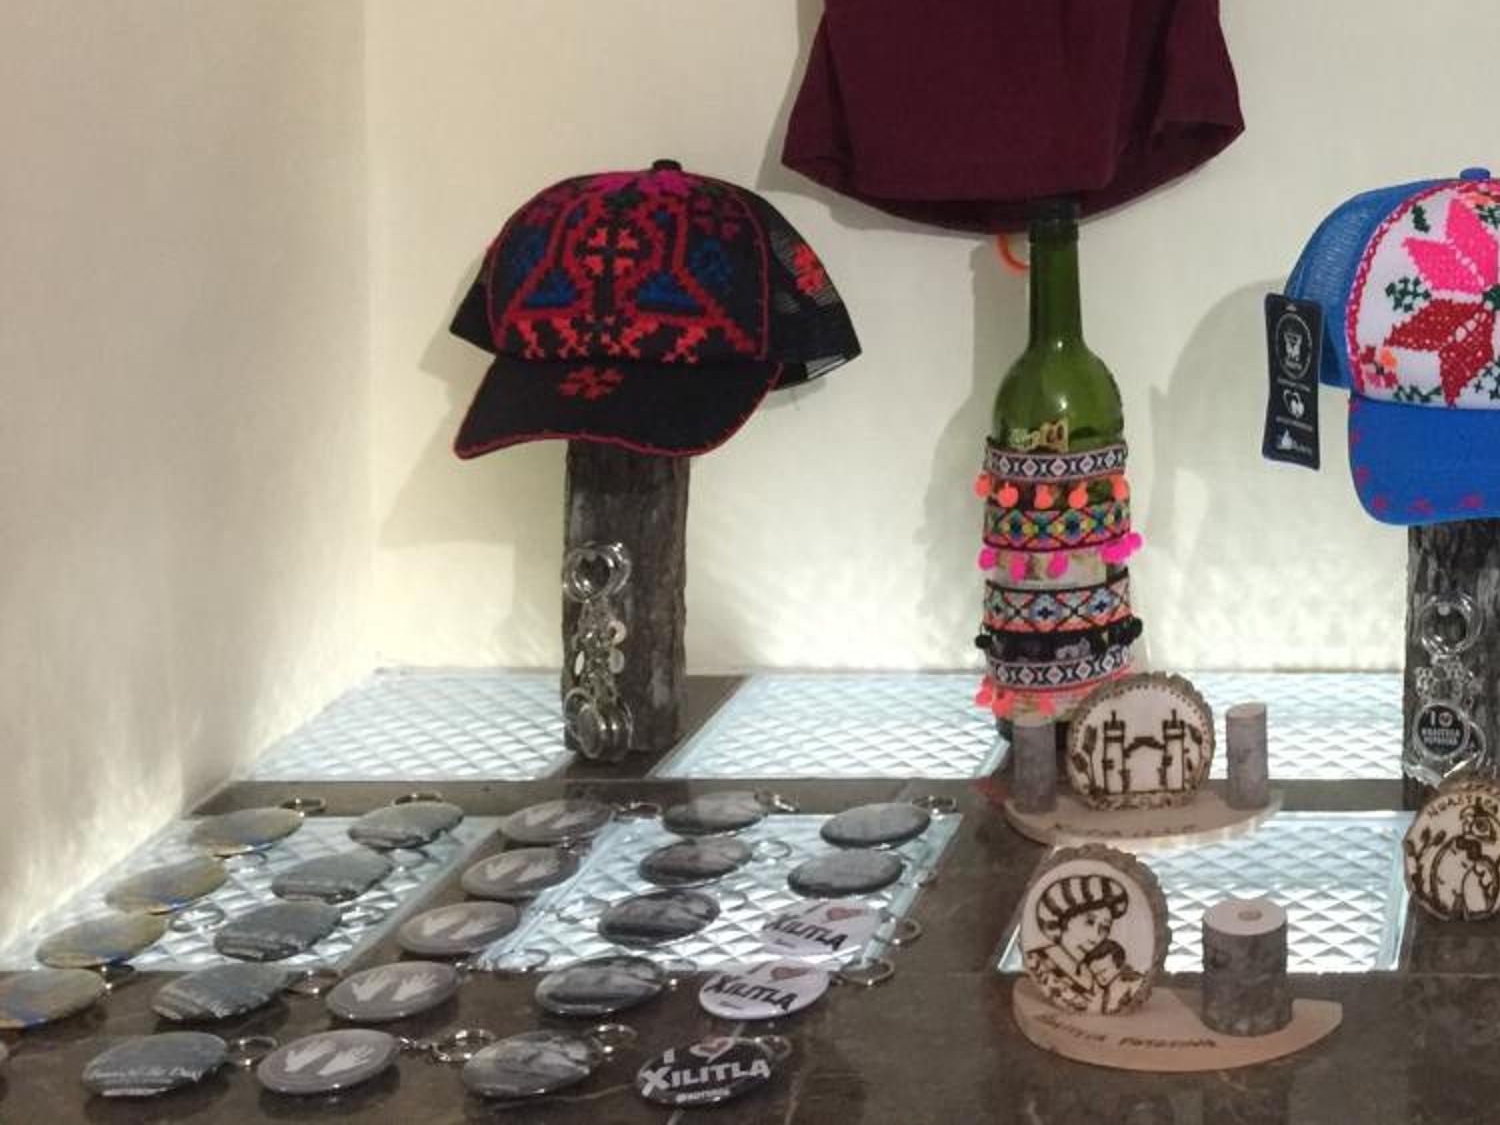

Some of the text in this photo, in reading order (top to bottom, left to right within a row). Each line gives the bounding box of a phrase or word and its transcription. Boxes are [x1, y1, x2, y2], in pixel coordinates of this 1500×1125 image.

[762, 913, 848, 951] XILITLA
[704, 975, 798, 1011] XILITLA
[640, 1059, 771, 1097] XILITLA
